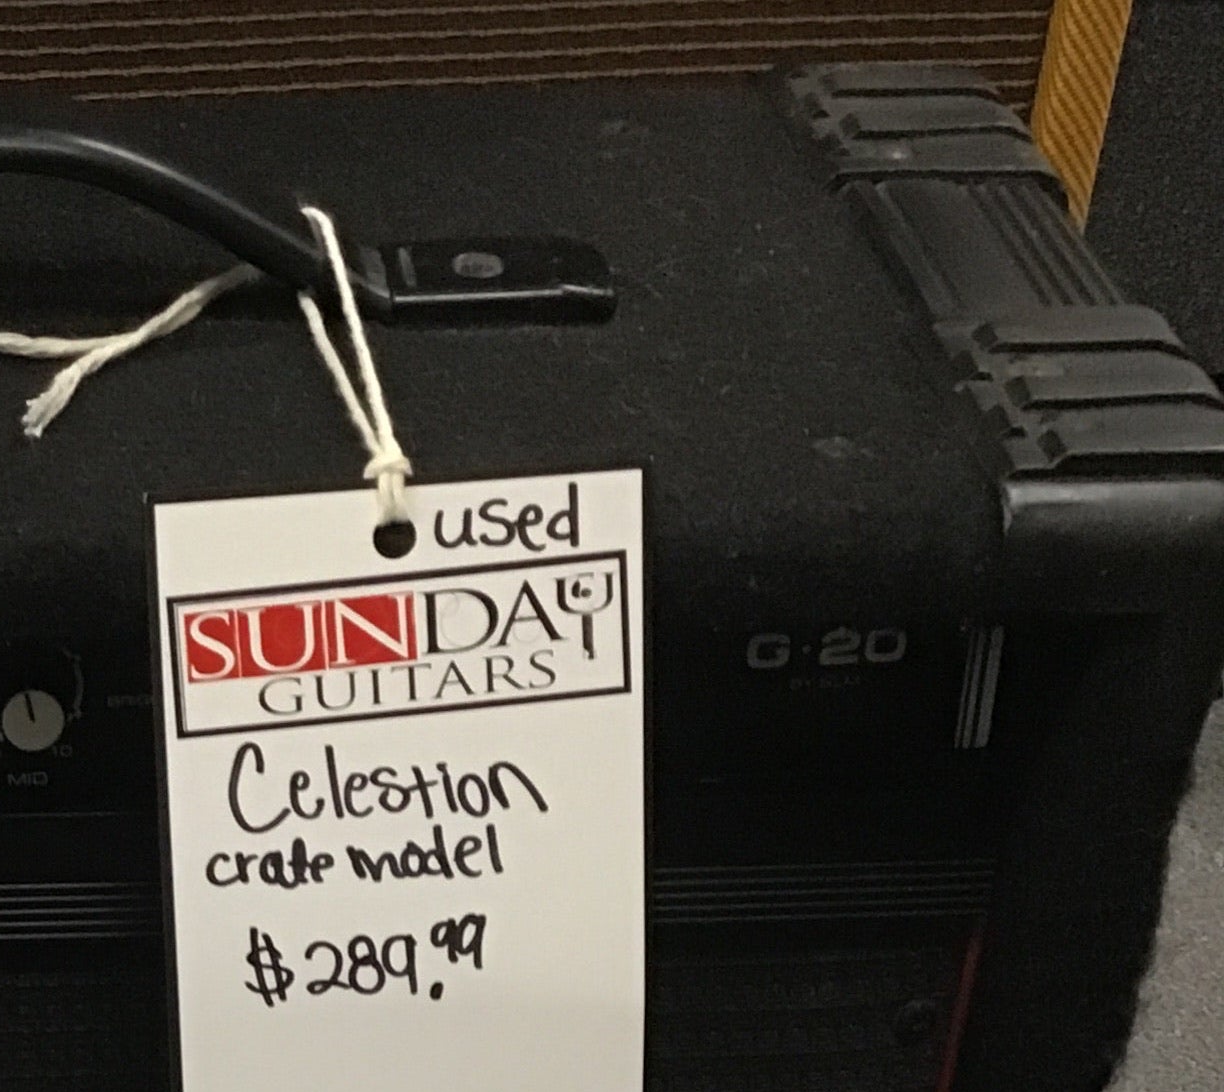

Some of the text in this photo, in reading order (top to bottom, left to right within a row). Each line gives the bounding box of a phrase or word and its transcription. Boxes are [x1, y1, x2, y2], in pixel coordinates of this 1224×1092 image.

[435, 483, 580, 550] used
[187, 571, 614, 682] SUNDAY
[259, 650, 557, 715] GUITARS
[7, 771, 48, 787] MID
[52, 745, 73, 758] 10
[229, 742, 548, 833] Celestion
[207, 825, 503, 888] crate model
